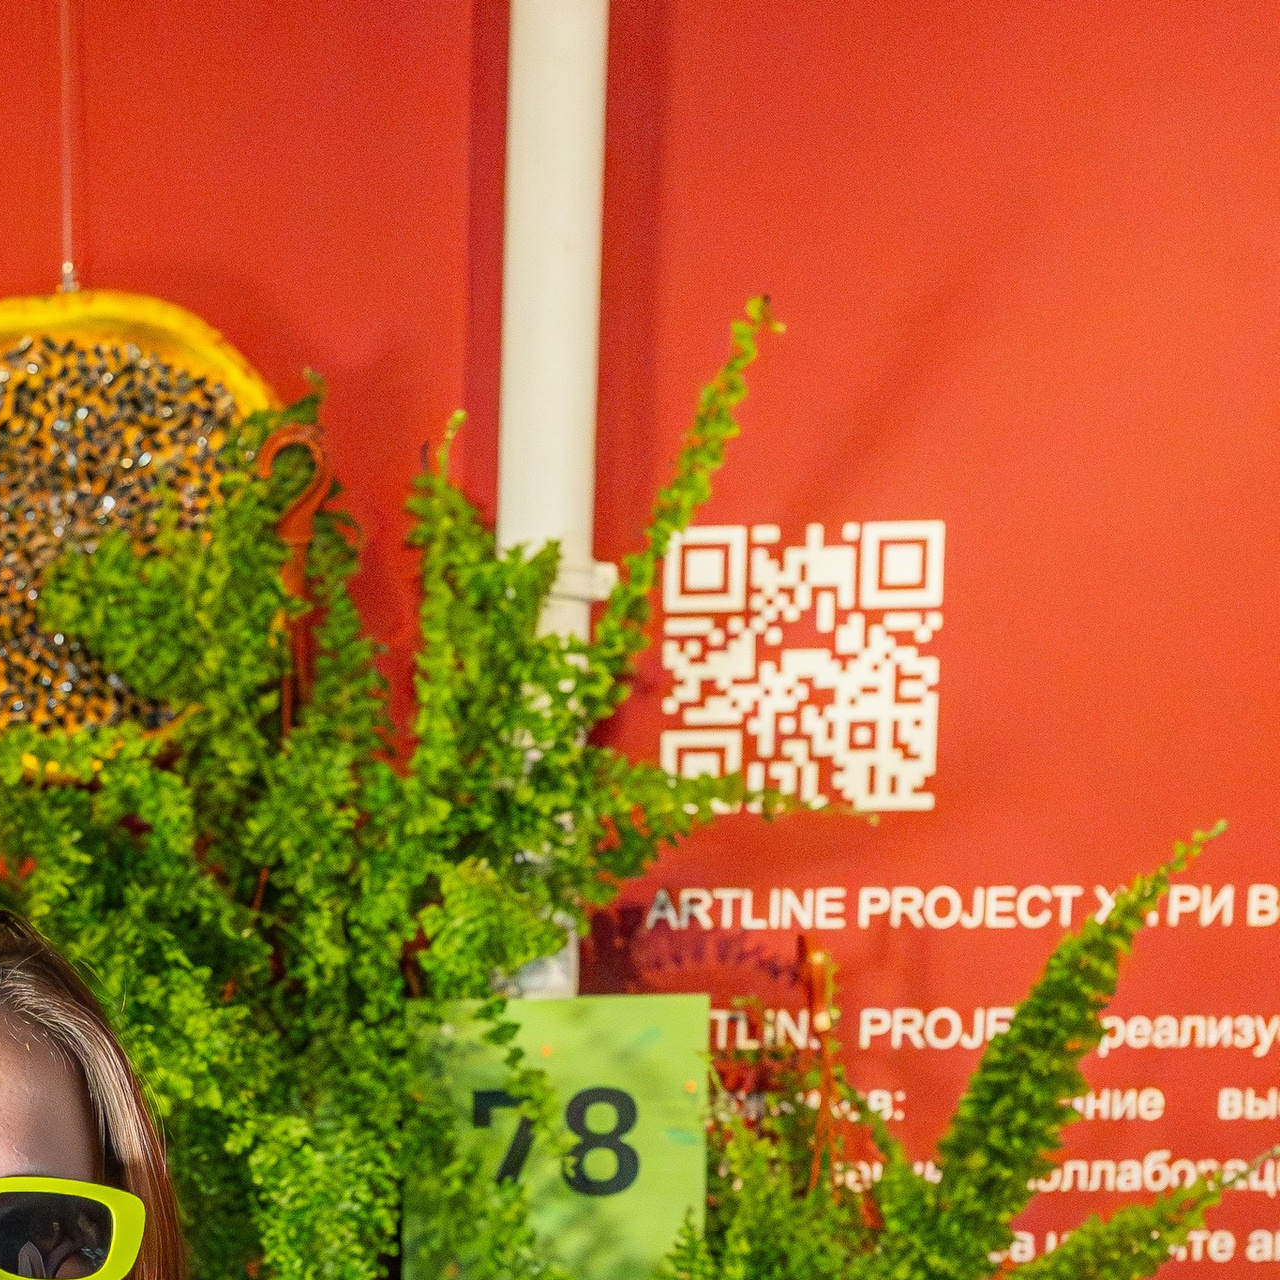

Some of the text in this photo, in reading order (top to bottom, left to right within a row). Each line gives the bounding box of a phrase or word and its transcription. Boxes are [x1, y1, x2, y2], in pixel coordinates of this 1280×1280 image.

[646, 886, 847, 930] ARTLINE
[857, 884, 1084, 930] PROJECT
[709, 1006, 1280, 1059] TLIN PROJE реализу
[472, 1085, 641, 1197] 78
